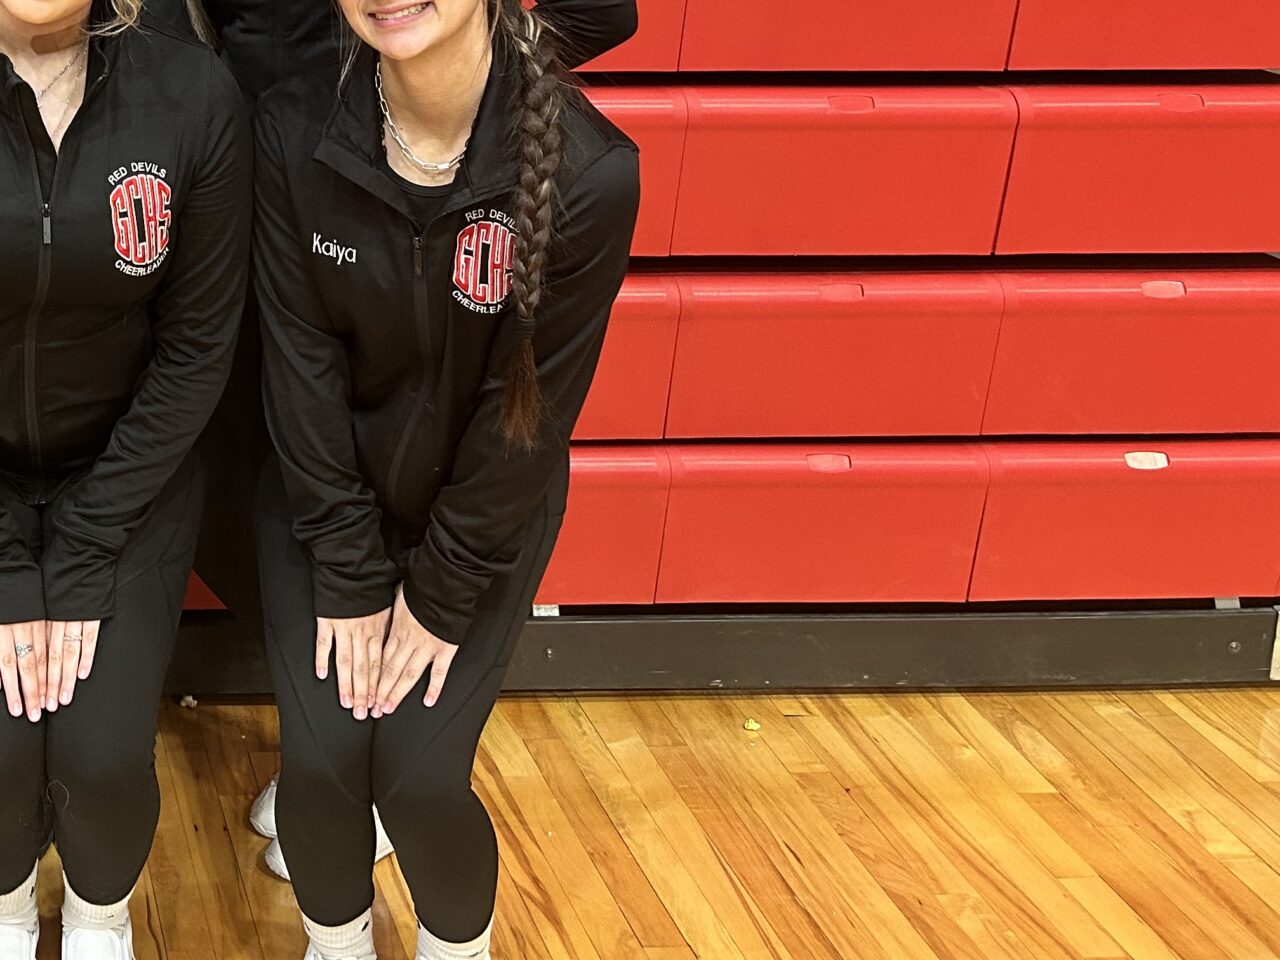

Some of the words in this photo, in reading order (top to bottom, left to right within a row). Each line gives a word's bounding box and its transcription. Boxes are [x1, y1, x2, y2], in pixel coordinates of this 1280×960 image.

[108, 167, 128, 186] RED
[131, 161, 167, 179] DEVILS
[109, 173, 172, 265] GCHS
[465, 208, 485, 222] RED
[115, 247, 170, 277] CHEERLEADER
[312, 232, 358, 266] Kaiya
